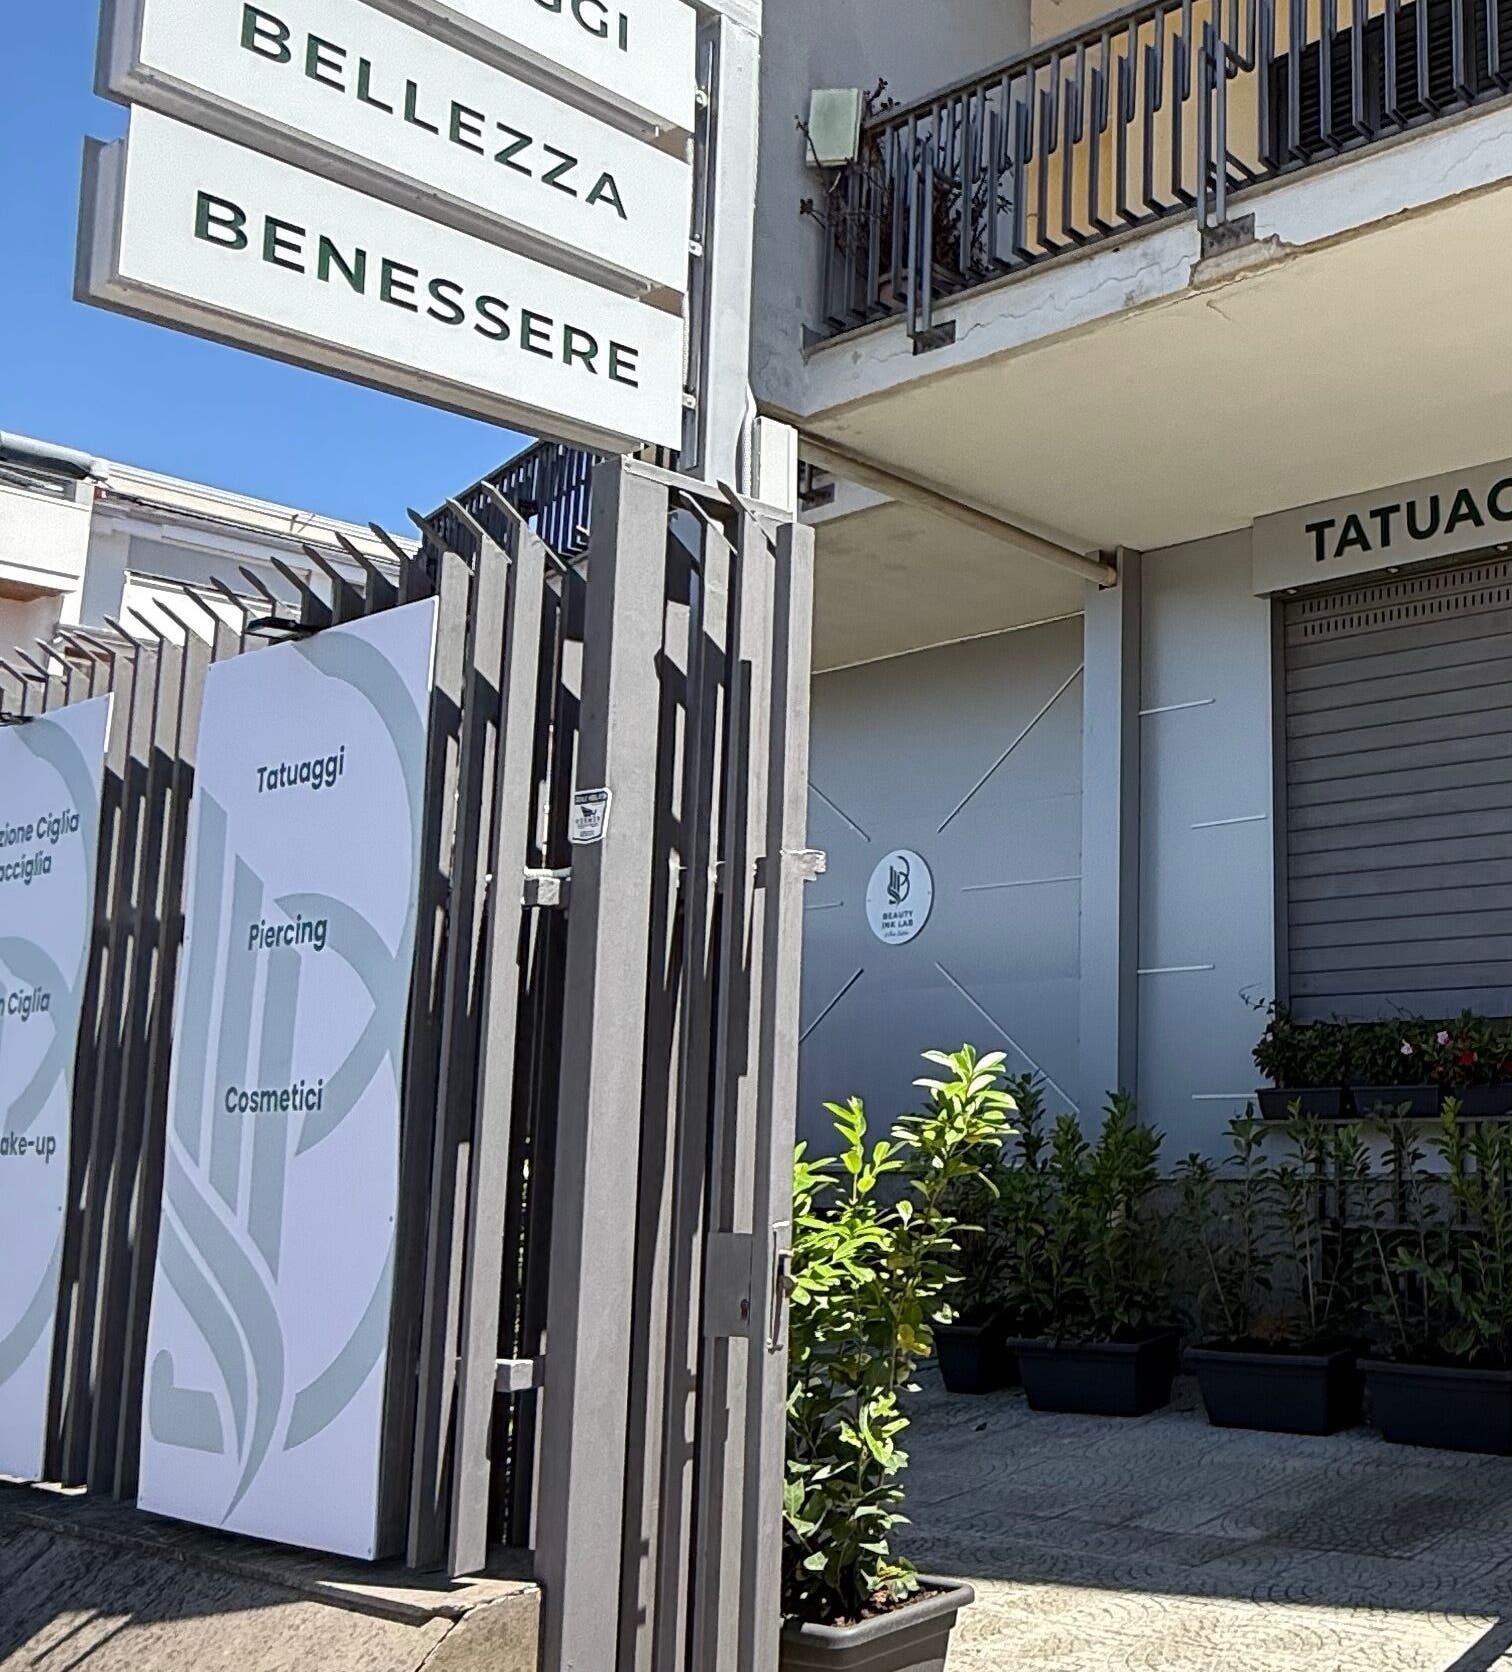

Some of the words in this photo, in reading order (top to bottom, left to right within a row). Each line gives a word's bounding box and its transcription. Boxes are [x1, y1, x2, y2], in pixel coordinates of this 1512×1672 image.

[533, 0, 628, 52] GI
[240, 2, 628, 221] BELLEZZA
[193, 189, 640, 389] BENESSERE
[257, 745, 345, 793] Tatuaggi
[37, 808, 81, 845] Ciglia
[248, 914, 328, 951] Piercing
[8, 986, 51, 1022] Ciglia
[225, 1079, 323, 1114] Cosmetici
[0, 1131, 57, 1165] ake-up
